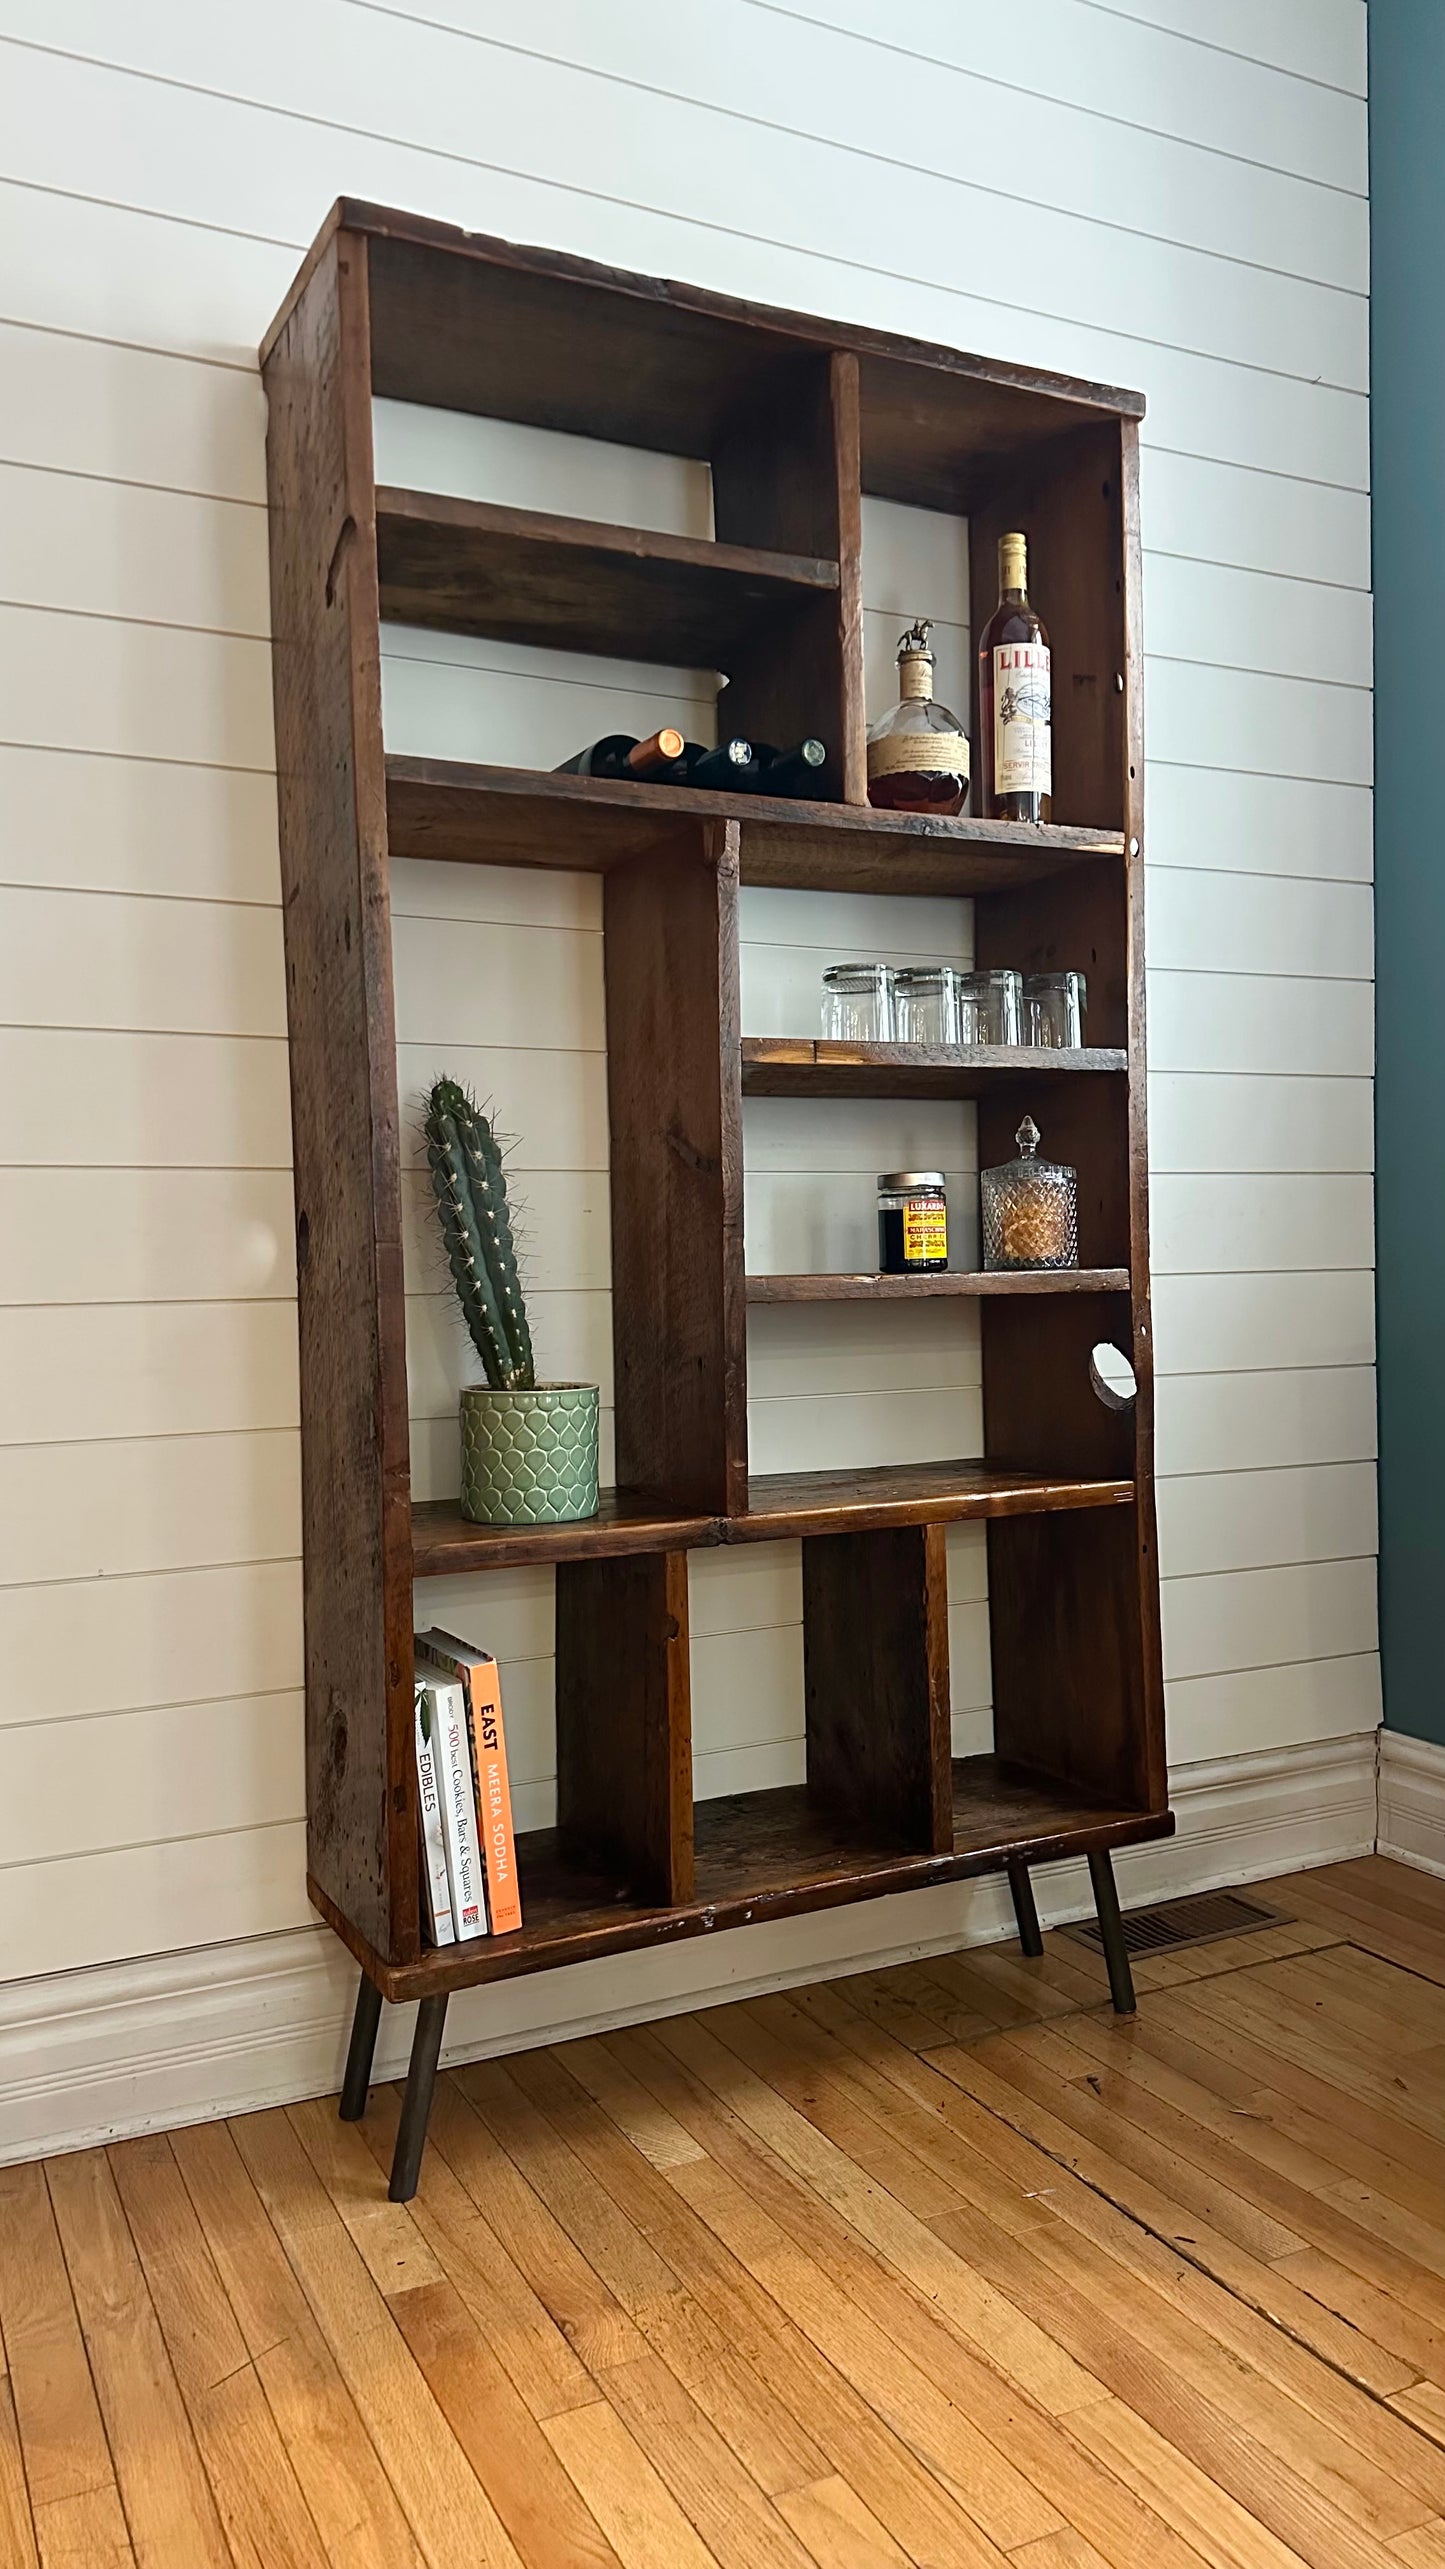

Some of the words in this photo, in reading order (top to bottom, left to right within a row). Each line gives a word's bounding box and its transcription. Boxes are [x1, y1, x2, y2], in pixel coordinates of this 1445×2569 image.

[448, 1723, 460, 1747] 500
[480, 1703, 498, 1750] EAST
[450, 1748, 458, 1768] best
[419, 1753, 436, 1812] EDIBLES
[452, 1769, 466, 1817] Cookies,
[487, 1763, 502, 1818] MEERA
[457, 1818, 468, 1844] Bars
[459, 1846, 471, 1856] &
[493, 1823, 509, 1883] SODHA
[460, 1858, 472, 1903] Squares
[463, 1914, 480, 1925] ROSE
